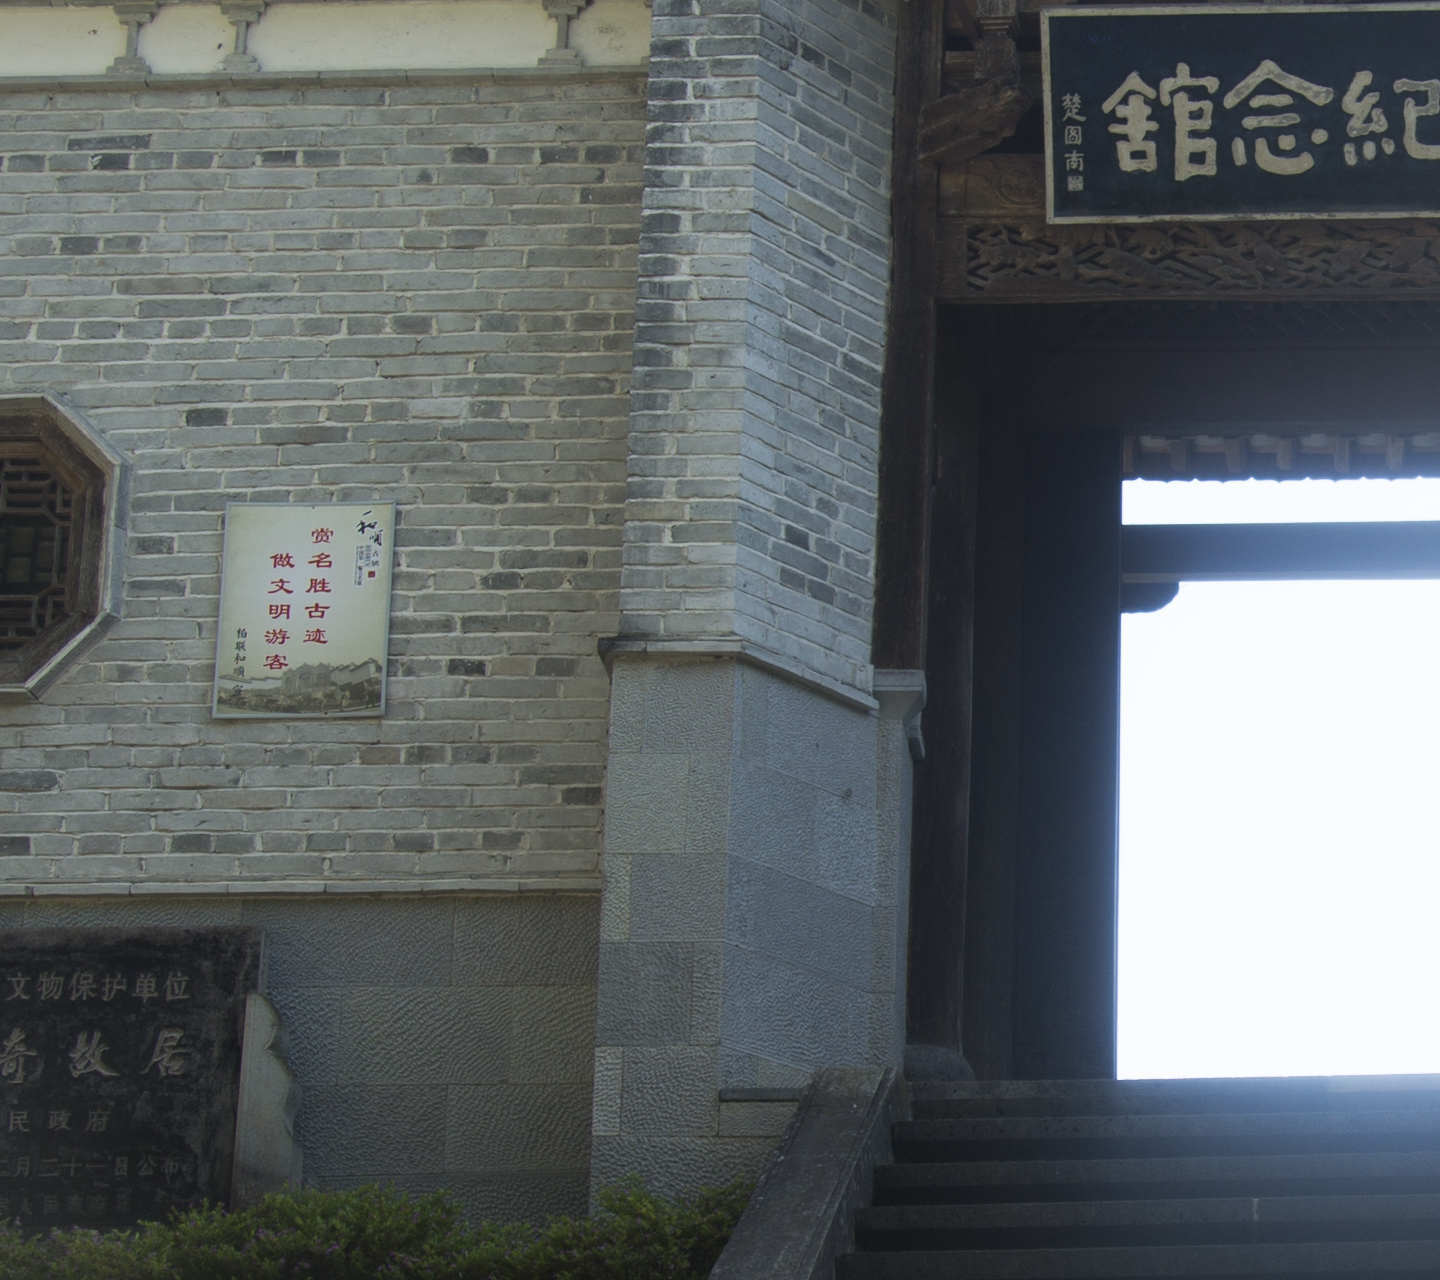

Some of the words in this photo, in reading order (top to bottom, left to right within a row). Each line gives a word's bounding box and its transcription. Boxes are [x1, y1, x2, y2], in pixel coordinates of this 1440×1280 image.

[263, 552, 296, 671] 做文明游客
[302, 527, 335, 645] 赏名胜古迹
